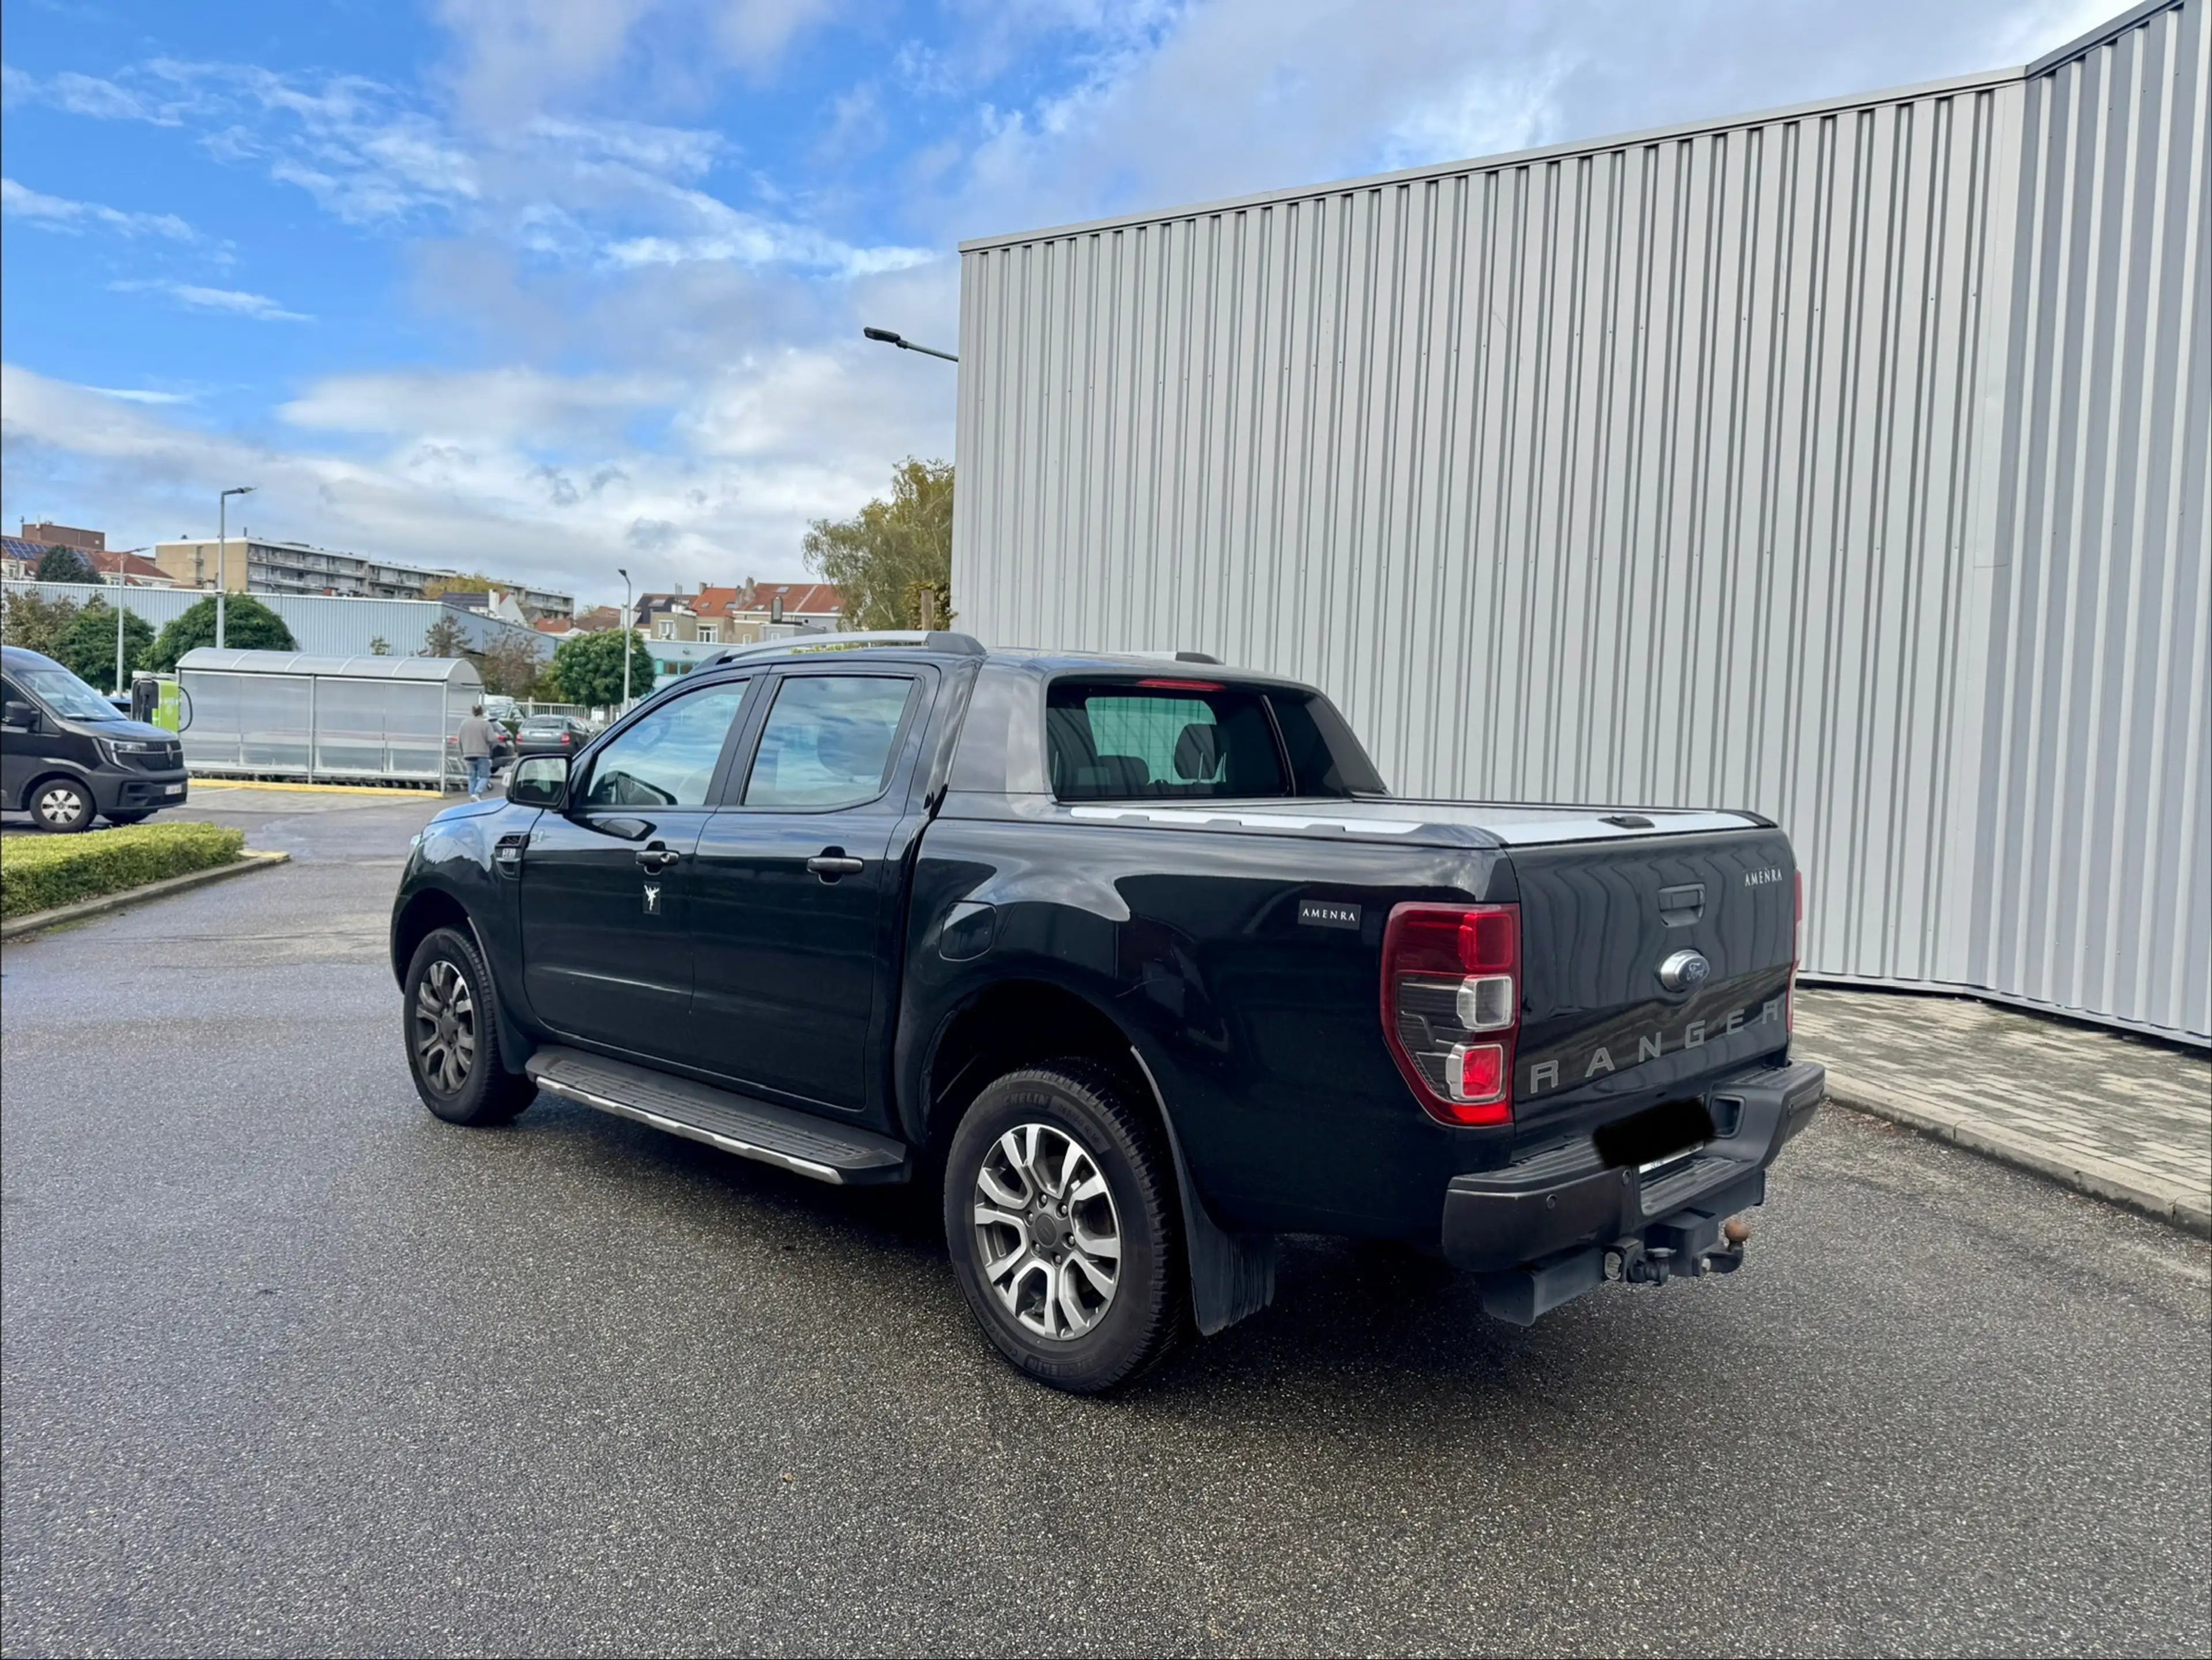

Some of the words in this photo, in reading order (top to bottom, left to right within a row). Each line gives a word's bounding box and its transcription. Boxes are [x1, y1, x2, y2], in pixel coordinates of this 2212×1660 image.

[1744, 869, 1783, 886] AMENRA
[1302, 908, 1355, 922] AMENRA
[1530, 999, 1778, 1094] RANGER
